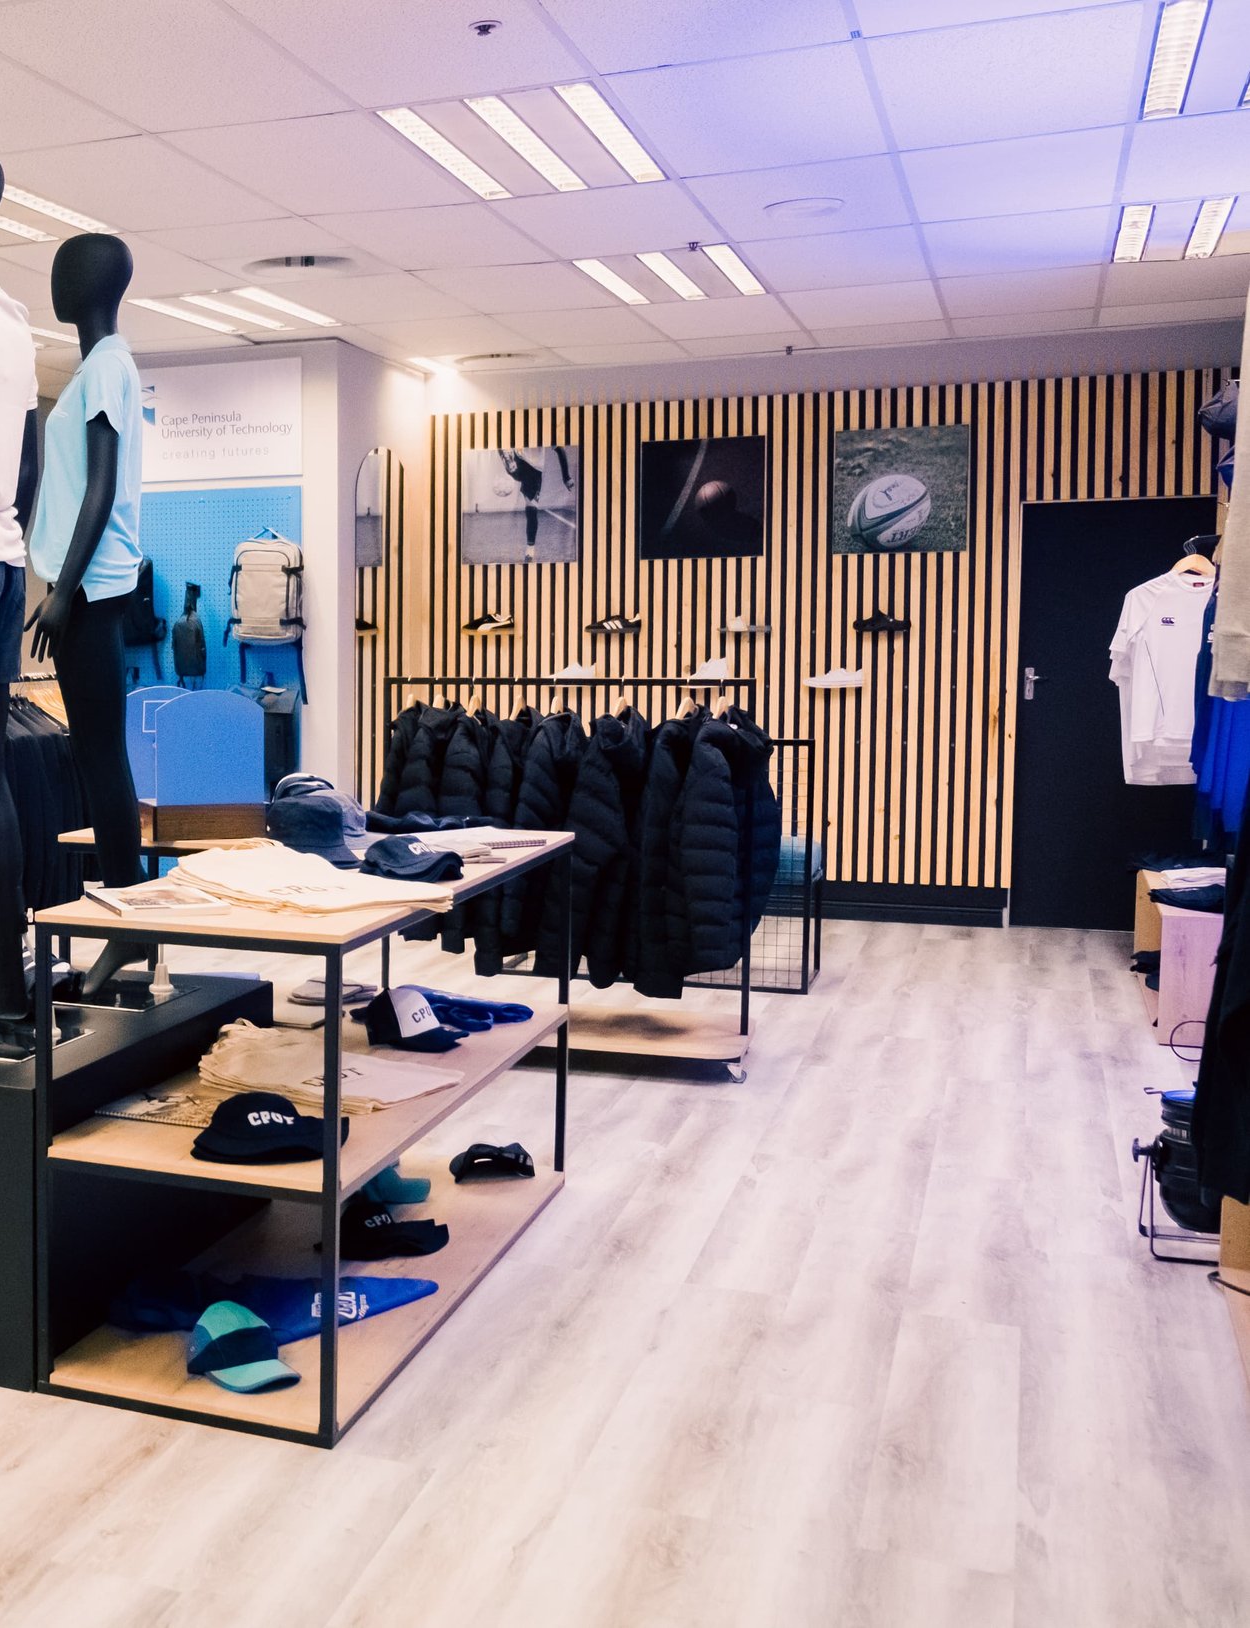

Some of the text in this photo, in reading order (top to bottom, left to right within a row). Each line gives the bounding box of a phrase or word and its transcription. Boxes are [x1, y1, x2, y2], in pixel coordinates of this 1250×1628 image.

[161, 411, 241, 428] Cape Peninsula
[161, 422, 293, 440] University of Technology
[162, 446, 270, 460] creating futures
